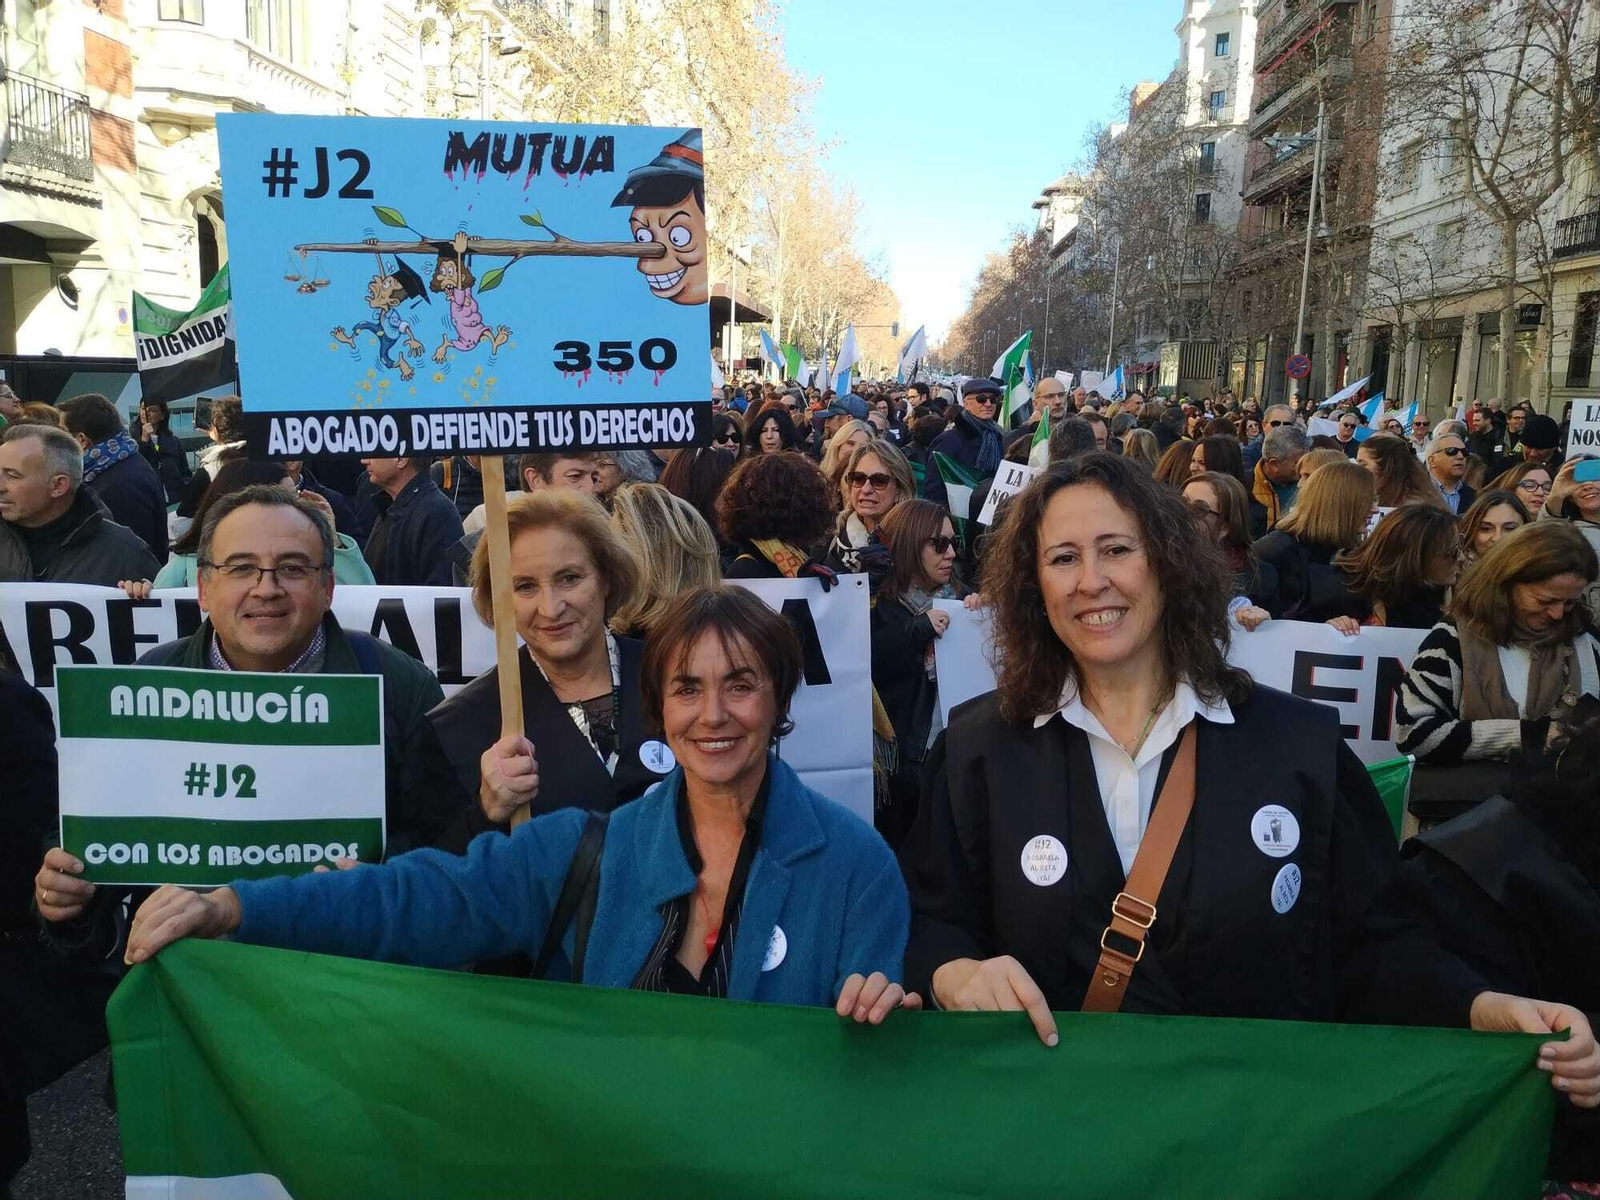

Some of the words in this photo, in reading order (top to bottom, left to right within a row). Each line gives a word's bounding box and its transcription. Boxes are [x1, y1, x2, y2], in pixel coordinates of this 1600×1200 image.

[262, 146, 375, 199] #J2
[443, 131, 615, 175] MUTUA
[138, 313, 228, 362] ¡DIGNIDA
[553, 338, 678, 373] 350
[268, 416, 407, 456] ABOGADO,
[411, 411, 530, 451] DEFIENDE
[534, 409, 573, 446] TUS
[579, 407, 695, 444] DERECHOS
[1005, 468, 1024, 487] LA
[110, 685, 329, 724] ANDALUCÍA
[183, 761, 258, 798] #J2
[84, 842, 149, 865] CON
[157, 842, 201, 866] LOS
[207, 842, 359, 867] ABOGADOS
